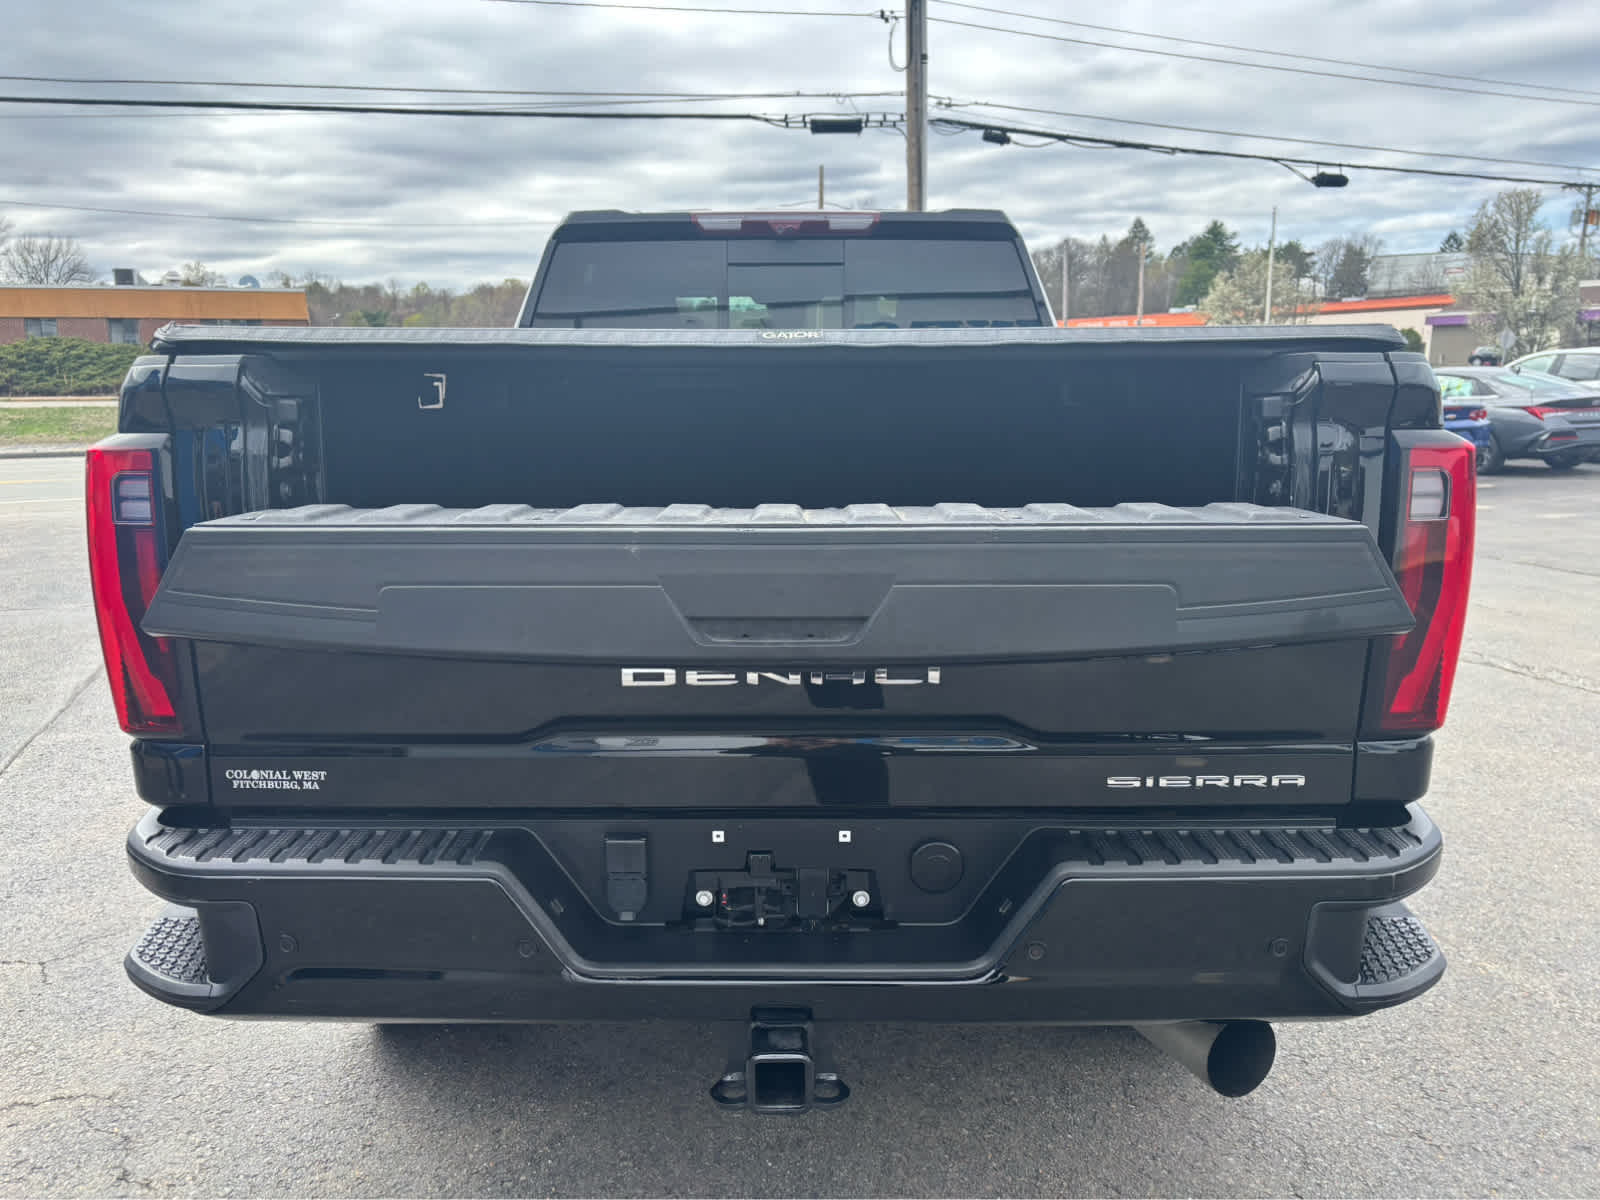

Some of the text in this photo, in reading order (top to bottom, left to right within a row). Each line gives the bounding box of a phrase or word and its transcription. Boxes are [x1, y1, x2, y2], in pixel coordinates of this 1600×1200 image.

[762, 331, 819, 339] GATOR
[225, 769, 327, 780] COLONIAL WEST
[232, 780, 320, 790] FITCHBURG, MA
[1106, 775, 1306, 787] SIERRA
